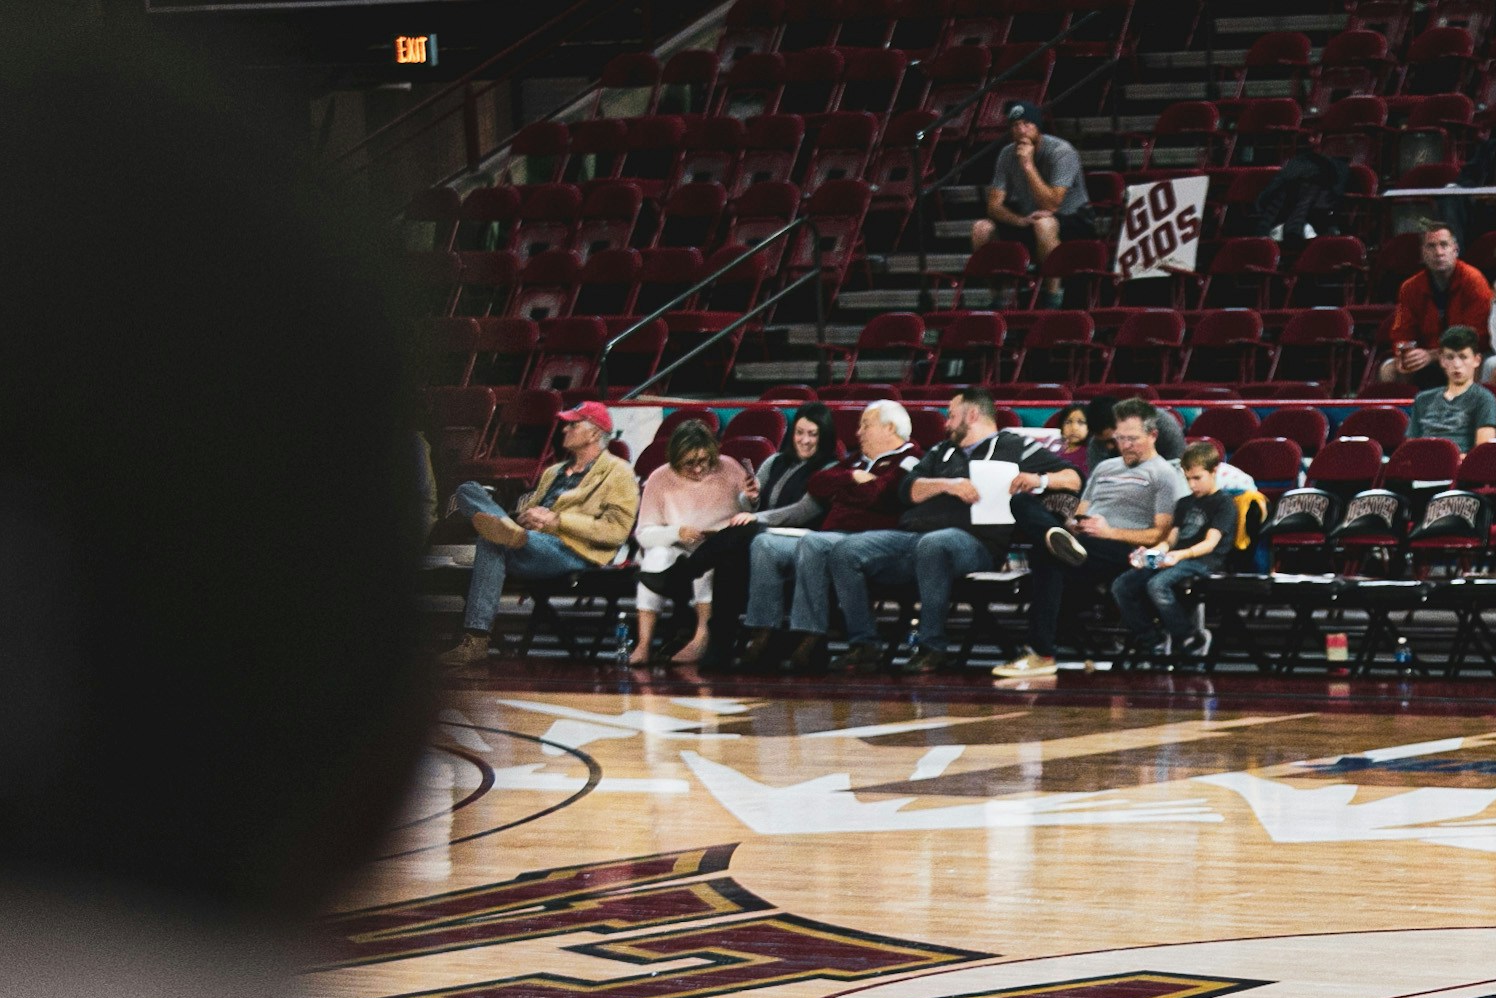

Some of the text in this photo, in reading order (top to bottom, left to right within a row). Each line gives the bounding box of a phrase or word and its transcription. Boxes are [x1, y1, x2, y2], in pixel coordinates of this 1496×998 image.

[396, 36, 428, 63] EXIT
[1126, 181, 1177, 240] GO
[1118, 204, 1201, 279] PIOS
[1273, 495, 1329, 526] DENVER
[1342, 496, 1399, 529] DENVER
[1422, 497, 1480, 530] DENVER
